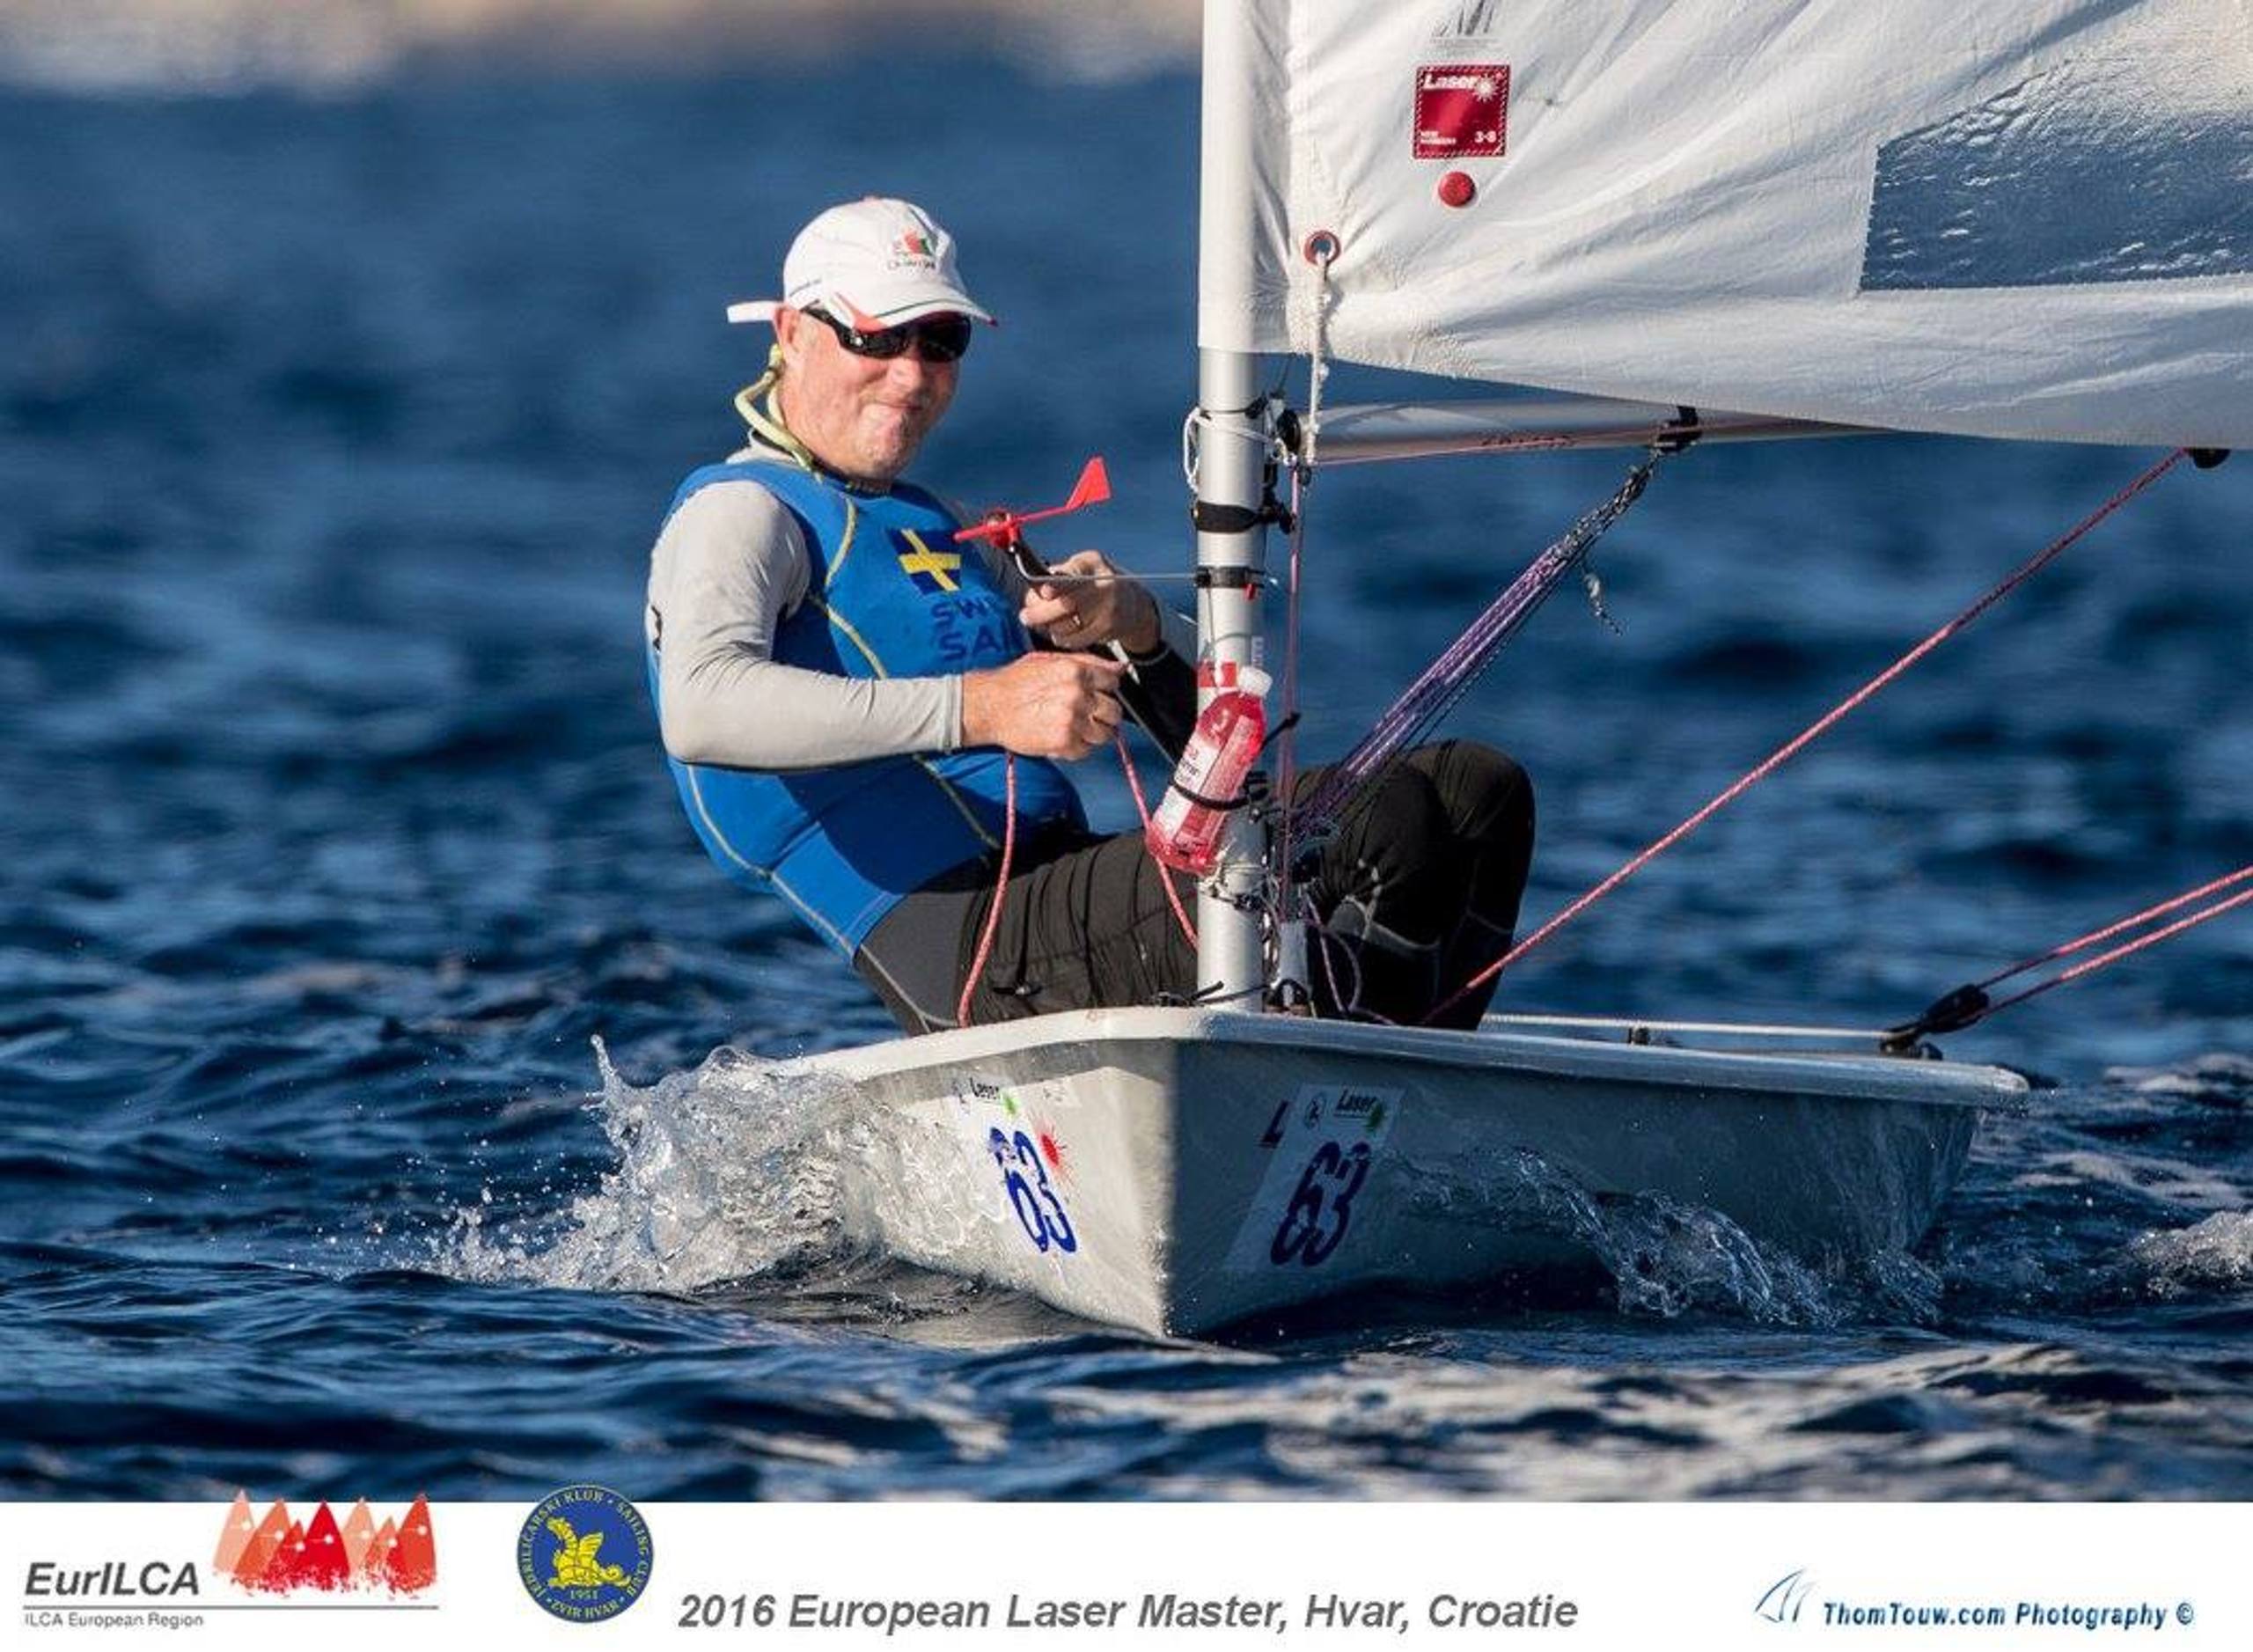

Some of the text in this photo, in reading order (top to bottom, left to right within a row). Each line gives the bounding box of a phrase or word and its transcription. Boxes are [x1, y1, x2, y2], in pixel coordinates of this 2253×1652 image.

[1423, 73, 1479, 89] Laser
[1335, 1088, 1376, 1112] Laser
[989, 1127, 1076, 1253] 63
[1270, 1142, 1372, 1266] 63
